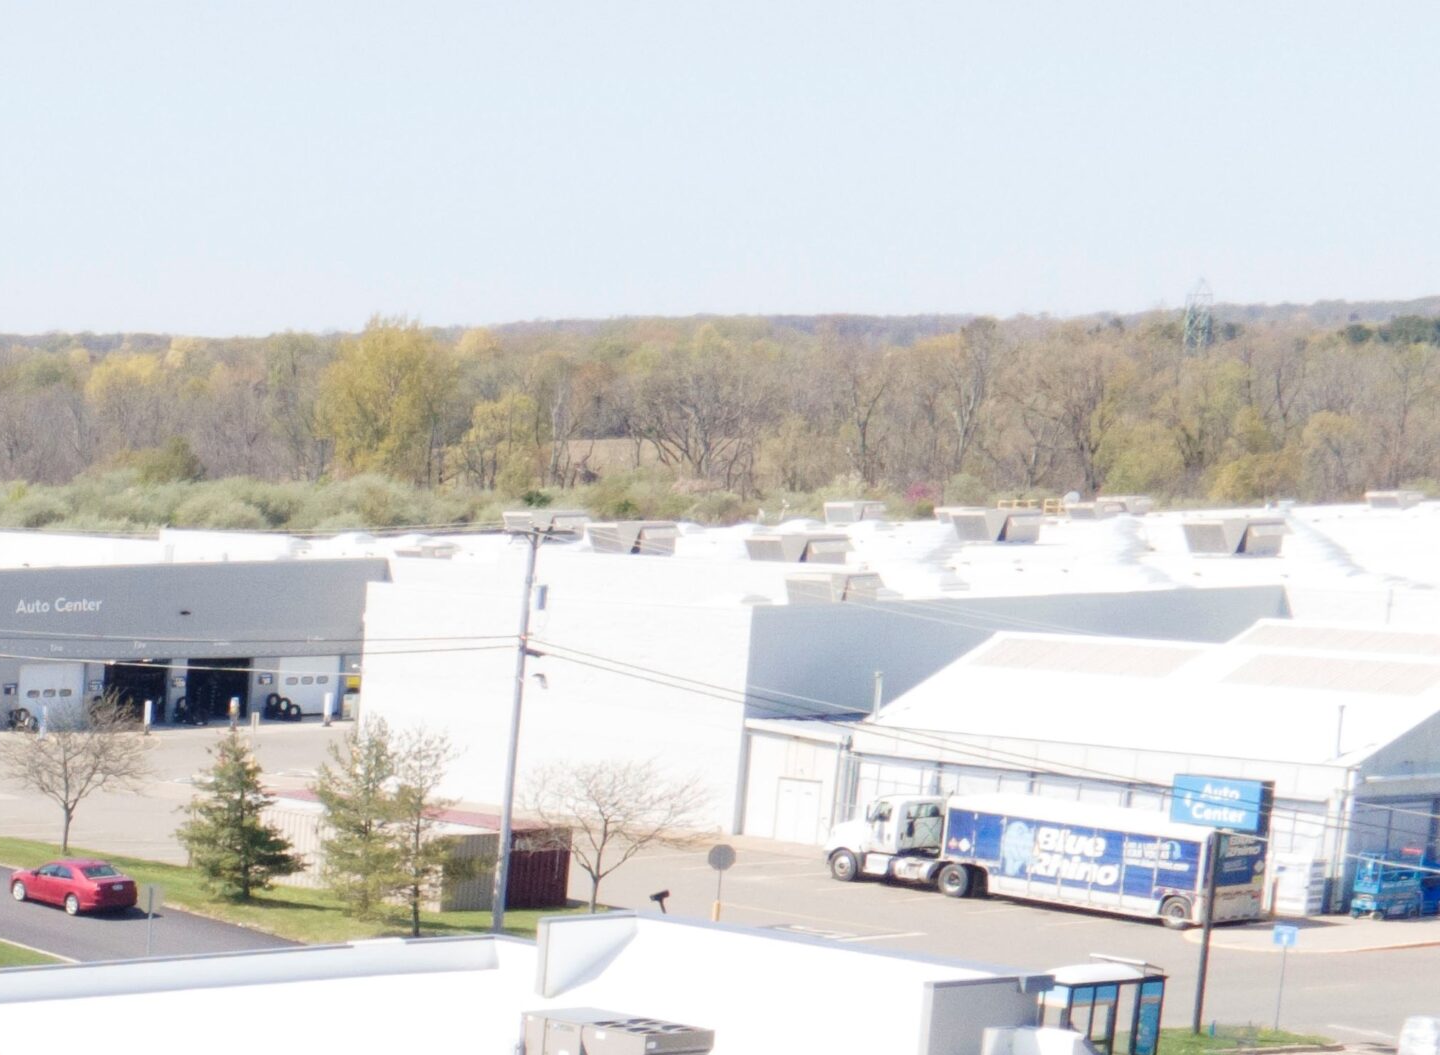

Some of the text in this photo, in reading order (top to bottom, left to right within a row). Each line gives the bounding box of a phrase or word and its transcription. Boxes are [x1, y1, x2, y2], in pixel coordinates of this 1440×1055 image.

[16, 597, 103, 614] Auto Center
[1201, 783, 1240, 801] Auto
[1191, 802, 1247, 823] Center
[1038, 826, 1106, 858] Blue
[1025, 853, 1120, 886] Rhino
